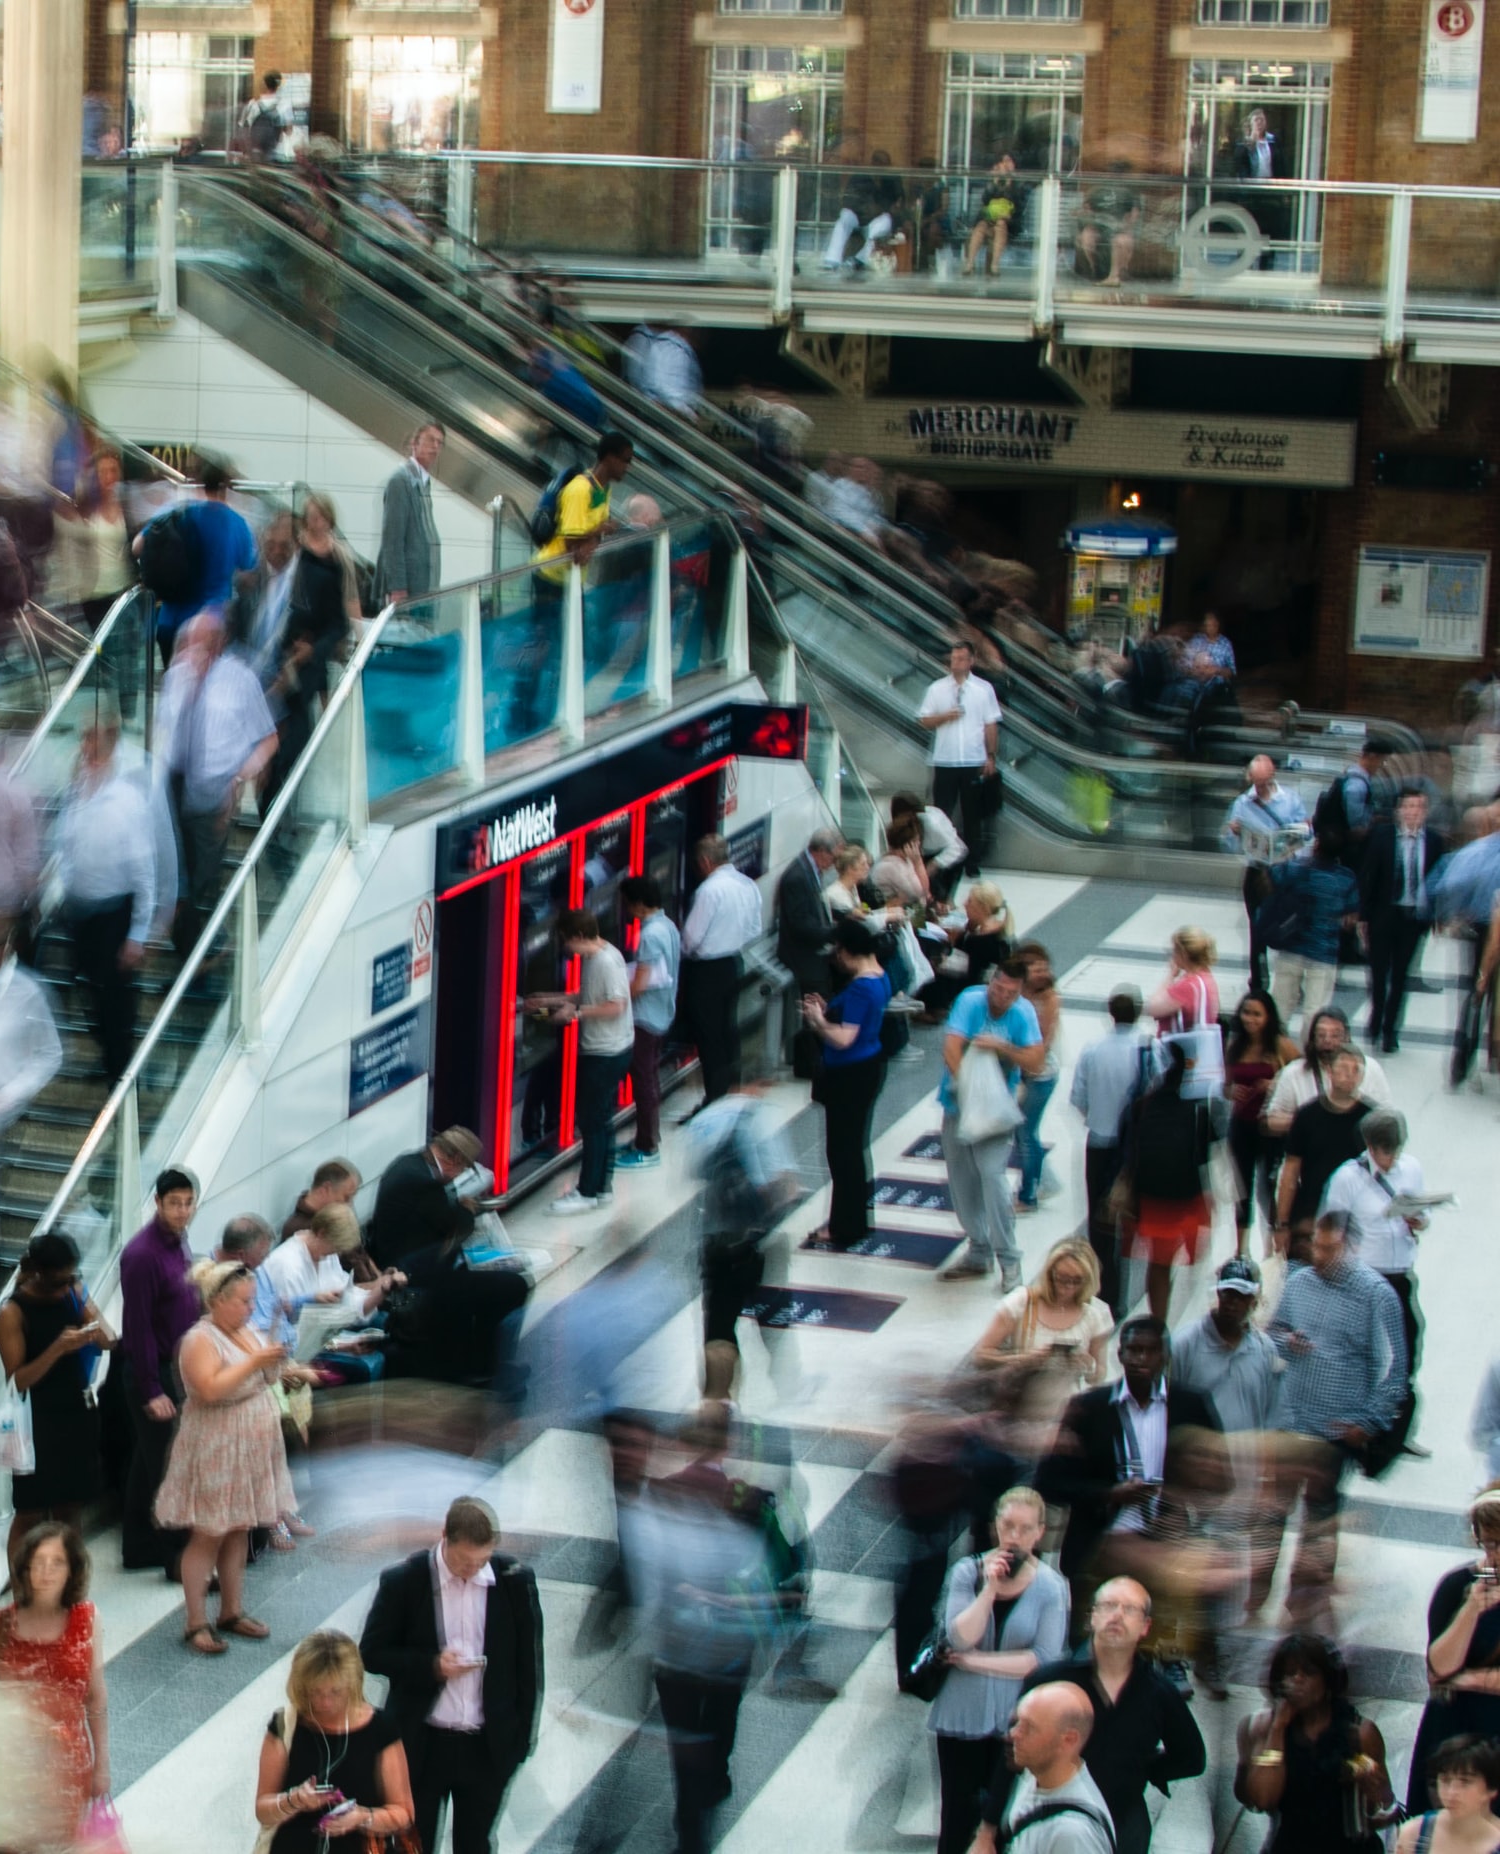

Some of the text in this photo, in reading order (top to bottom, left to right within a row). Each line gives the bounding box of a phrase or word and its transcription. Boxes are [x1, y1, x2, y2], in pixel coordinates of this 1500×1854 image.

[1447, 5, 1465, 31] B
[909, 405, 1079, 442] MERCHANT
[1185, 424, 1290, 447] Freehouse
[930, 438, 1054, 460] BISHOPSGATE
[1211, 446, 1285, 466] Kitchen
[493, 794, 557, 866] NatWest
